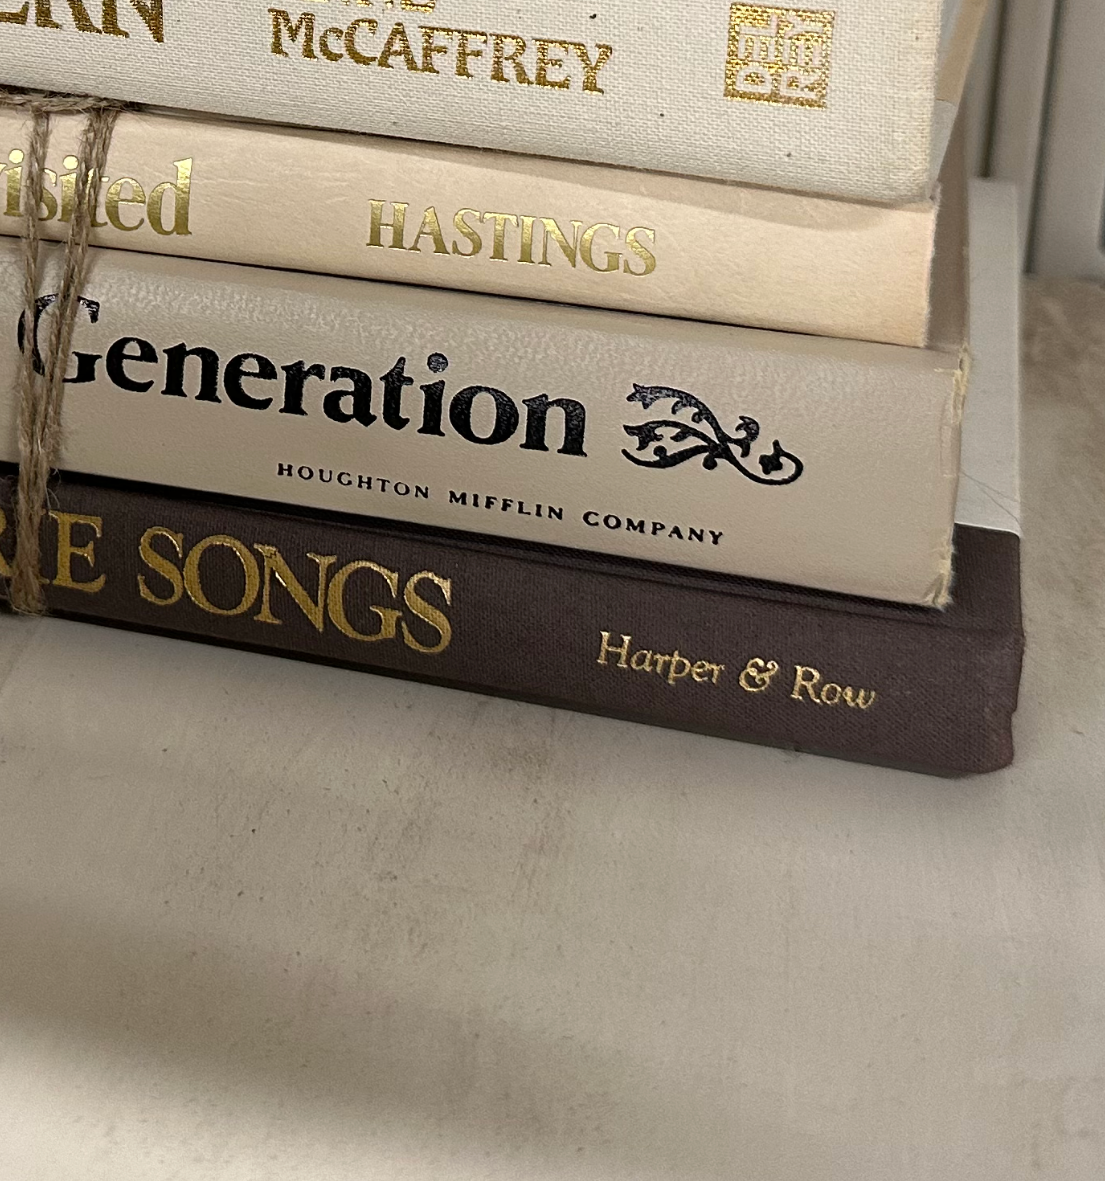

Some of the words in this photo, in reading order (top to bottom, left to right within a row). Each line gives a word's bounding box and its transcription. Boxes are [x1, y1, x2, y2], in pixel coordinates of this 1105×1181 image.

[268, 7, 615, 98] McCAFFREY
[365, 196, 659, 279] HASTINGS
[16, 292, 589, 458] Generation
[276, 460, 432, 501] HOUGHTON
[447, 488, 565, 522] MIFFLIN
[581, 509, 726, 548] COMPANY
[137, 525, 455, 656] SONGS
[595, 630, 726, 691] Harper
[738, 656, 779, 695] &
[790, 665, 878, 712] Row
